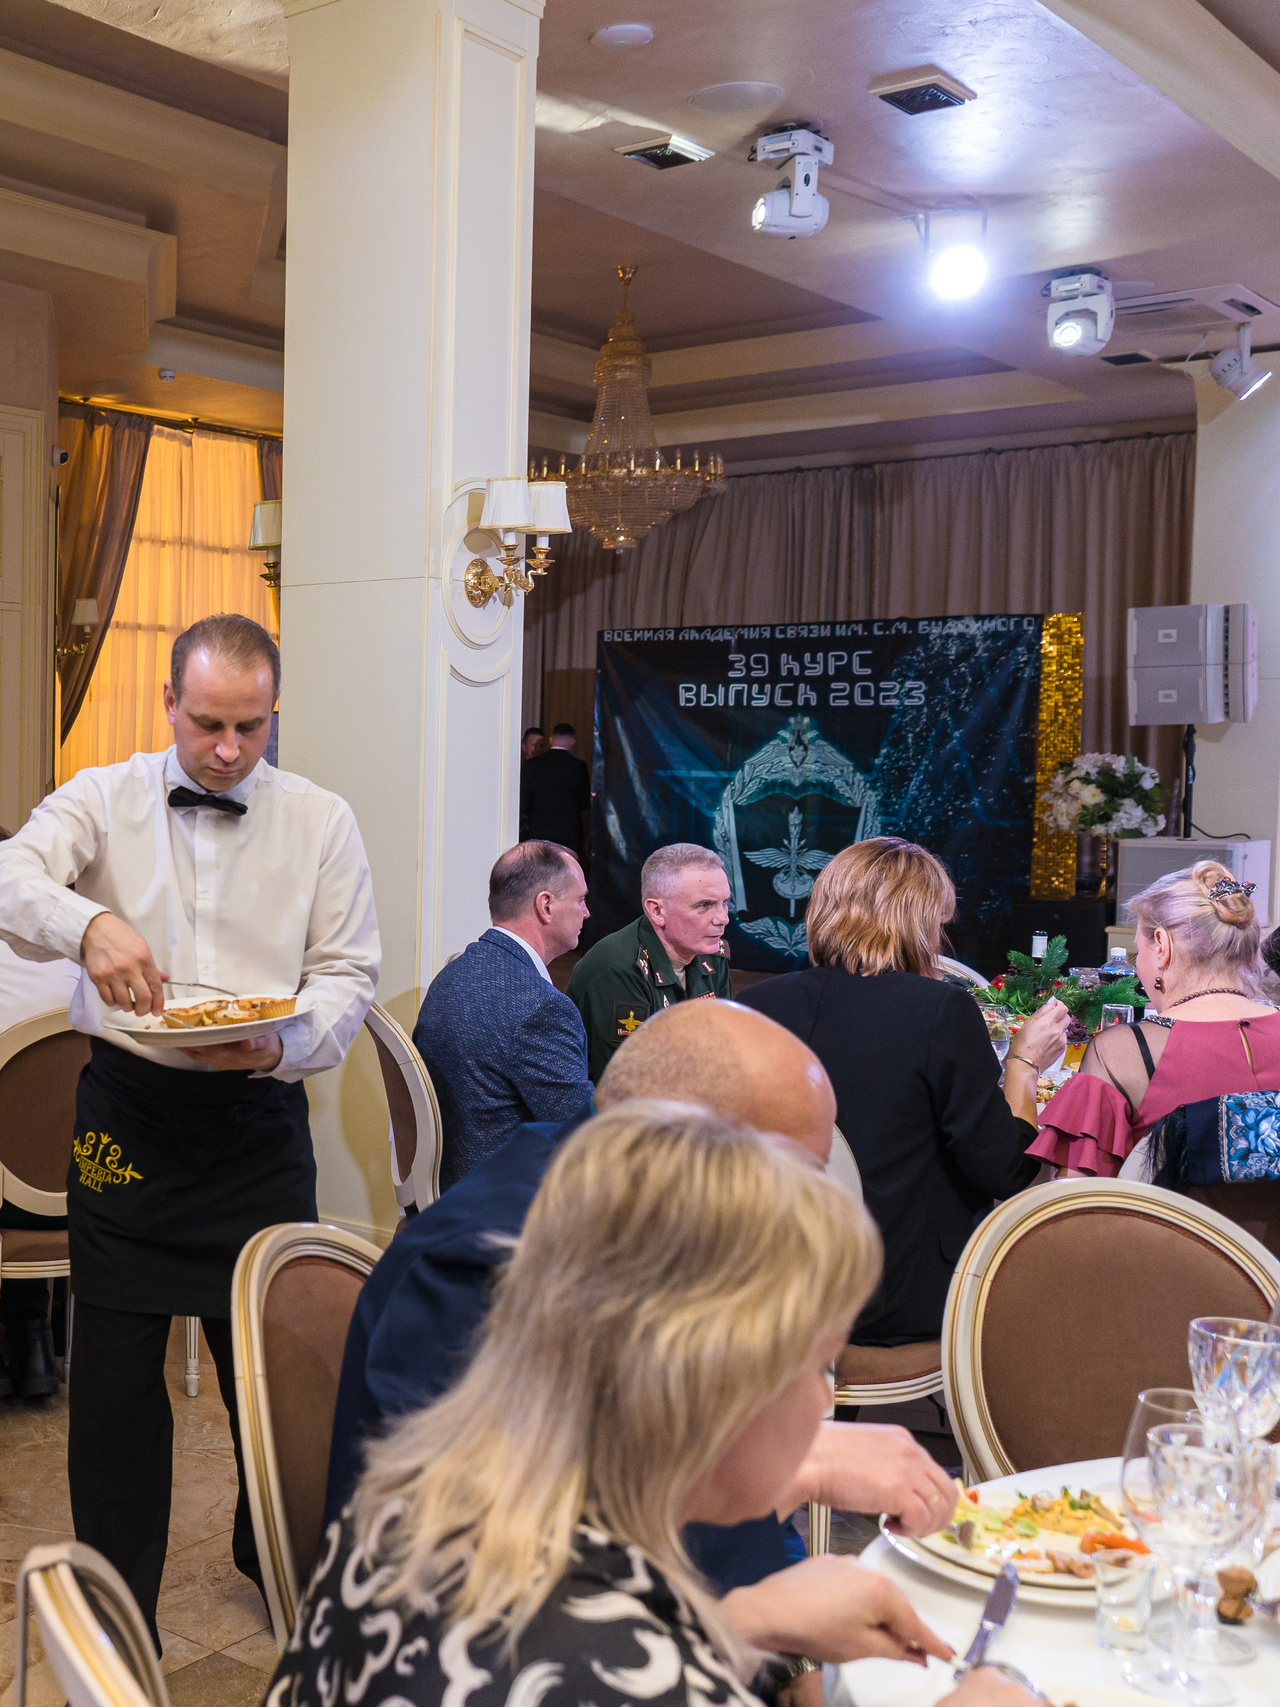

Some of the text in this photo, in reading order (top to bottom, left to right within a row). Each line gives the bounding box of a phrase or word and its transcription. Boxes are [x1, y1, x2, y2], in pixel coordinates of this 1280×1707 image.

[604, 629, 674, 642] ВОЕННАЯ
[679, 626, 770, 642] АКАДЕМИЯ
[775, 623, 830, 639] СВЯЗИ
[835, 623, 868, 636] ИМ.
[917, 616, 1035, 636] БУДНОГО
[728, 651, 873, 677] 39 КУРС
[678, 681, 926, 707] ВЫПУСК 2023
